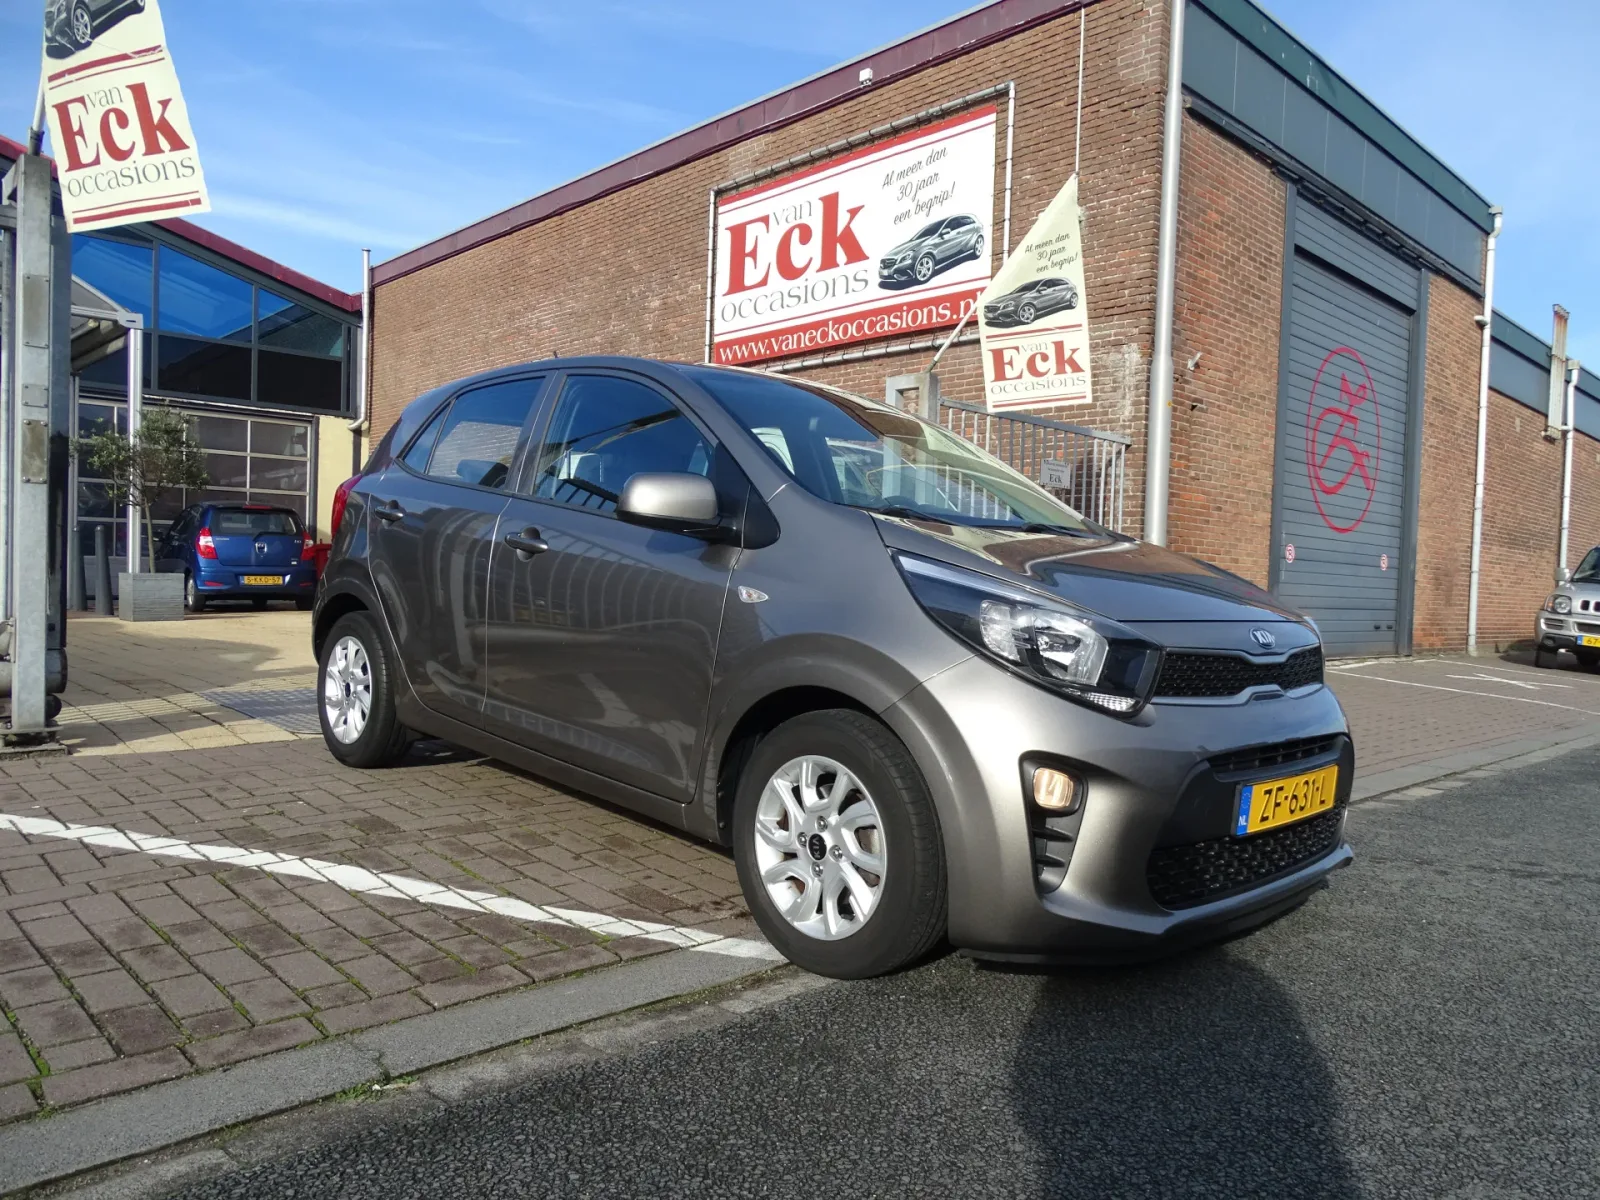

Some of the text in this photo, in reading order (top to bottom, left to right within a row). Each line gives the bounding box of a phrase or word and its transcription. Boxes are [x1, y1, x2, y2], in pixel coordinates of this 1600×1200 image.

[52, 82, 190, 172] van Eck
[67, 156, 196, 198] occasions
[881, 147, 949, 189] Al meer dan
[896, 172, 940, 203] 30 jaar
[893, 181, 956, 225] een begrip!
[722, 191, 870, 297] van Eck
[1025, 244, 1034, 254] Al
[1054, 233, 1071, 244] dan
[1035, 251, 1078, 274] een begrip!
[1036, 246, 1066, 262] 30 jaar
[720, 268, 869, 323] occasions
[987, 340, 1085, 382] van Eck
[990, 375, 1086, 395] occasions
[1253, 630, 1275, 644] KIA
[1258, 773, 1326, 824] ZF-631-L
[1238, 815, 1248, 827] NL
